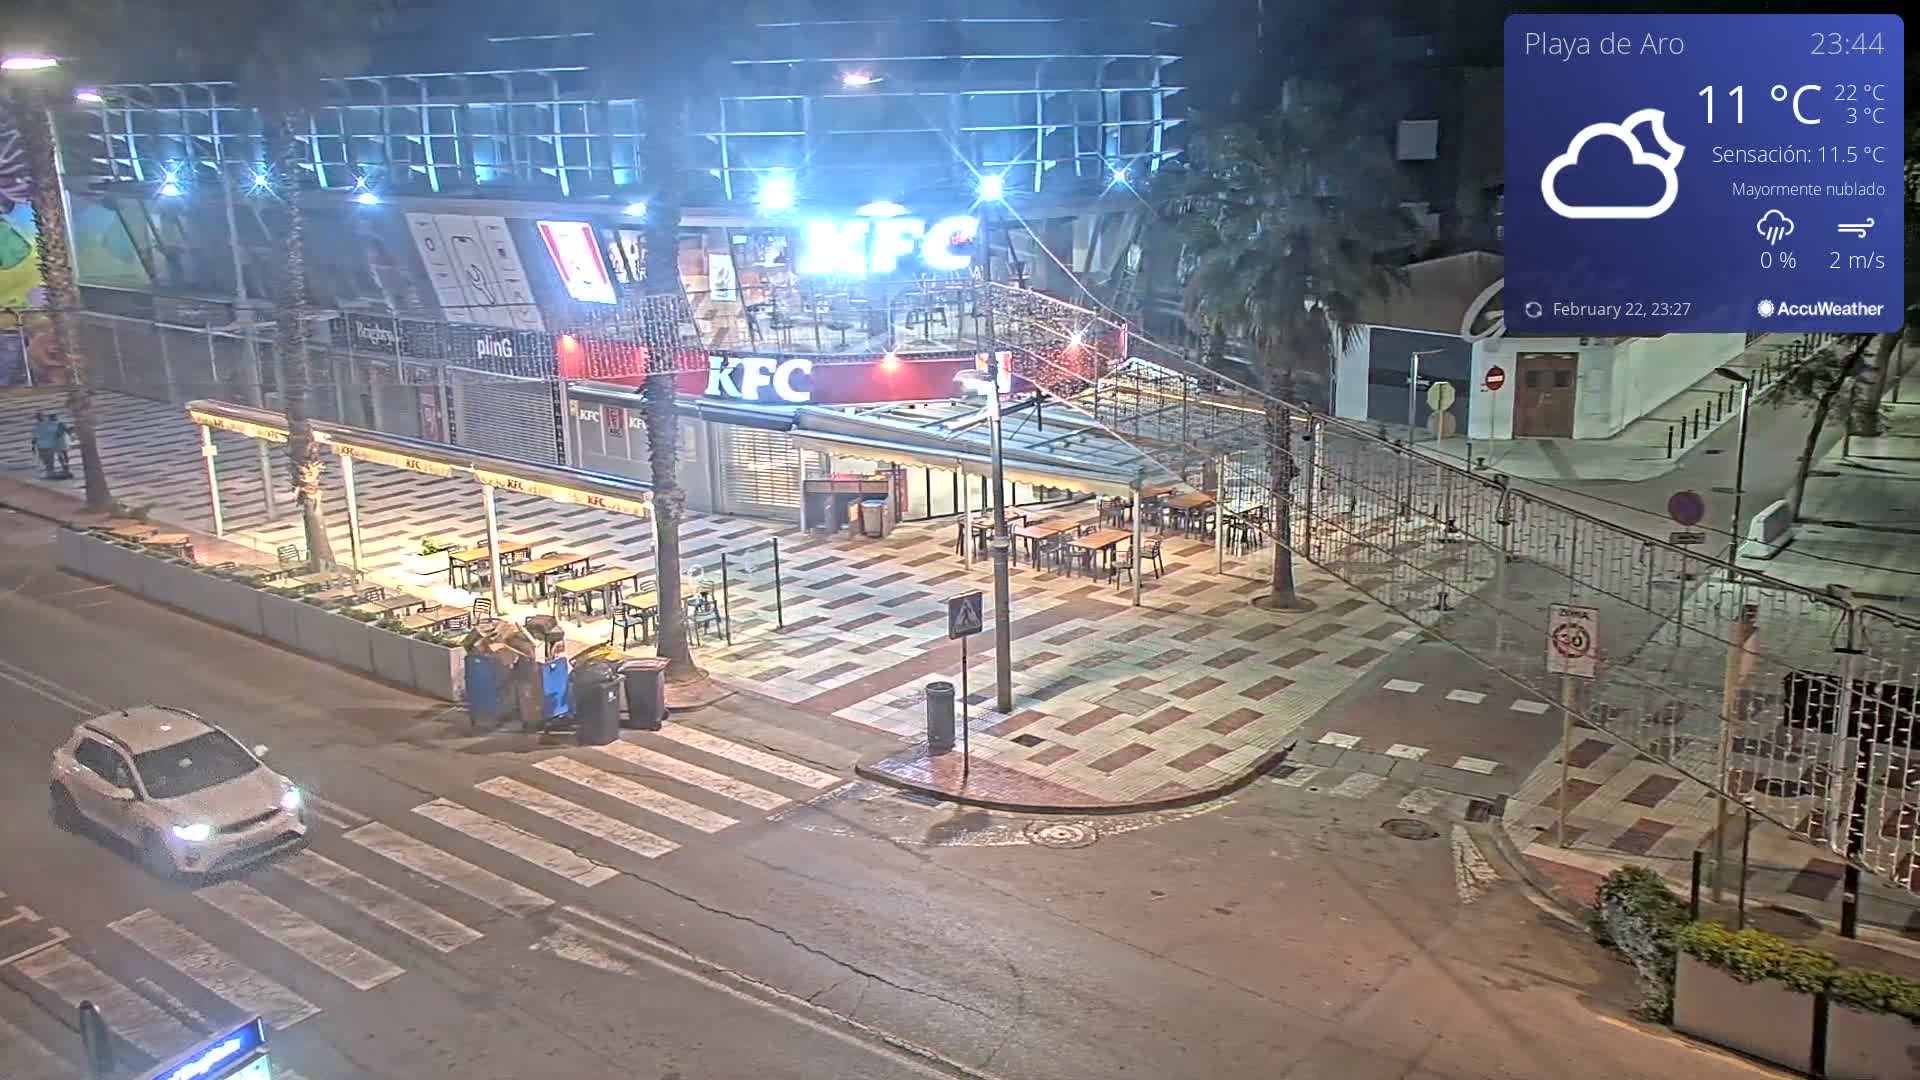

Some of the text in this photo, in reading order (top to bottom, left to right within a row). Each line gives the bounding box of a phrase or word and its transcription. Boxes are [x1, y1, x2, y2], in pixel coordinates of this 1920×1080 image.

[803, 215, 979, 280] KFC
[704, 355, 812, 401] KFC
[580, 409, 600, 422] KFC
[507, 479, 524, 491] KFC
[587, 495, 605, 508] KFC
